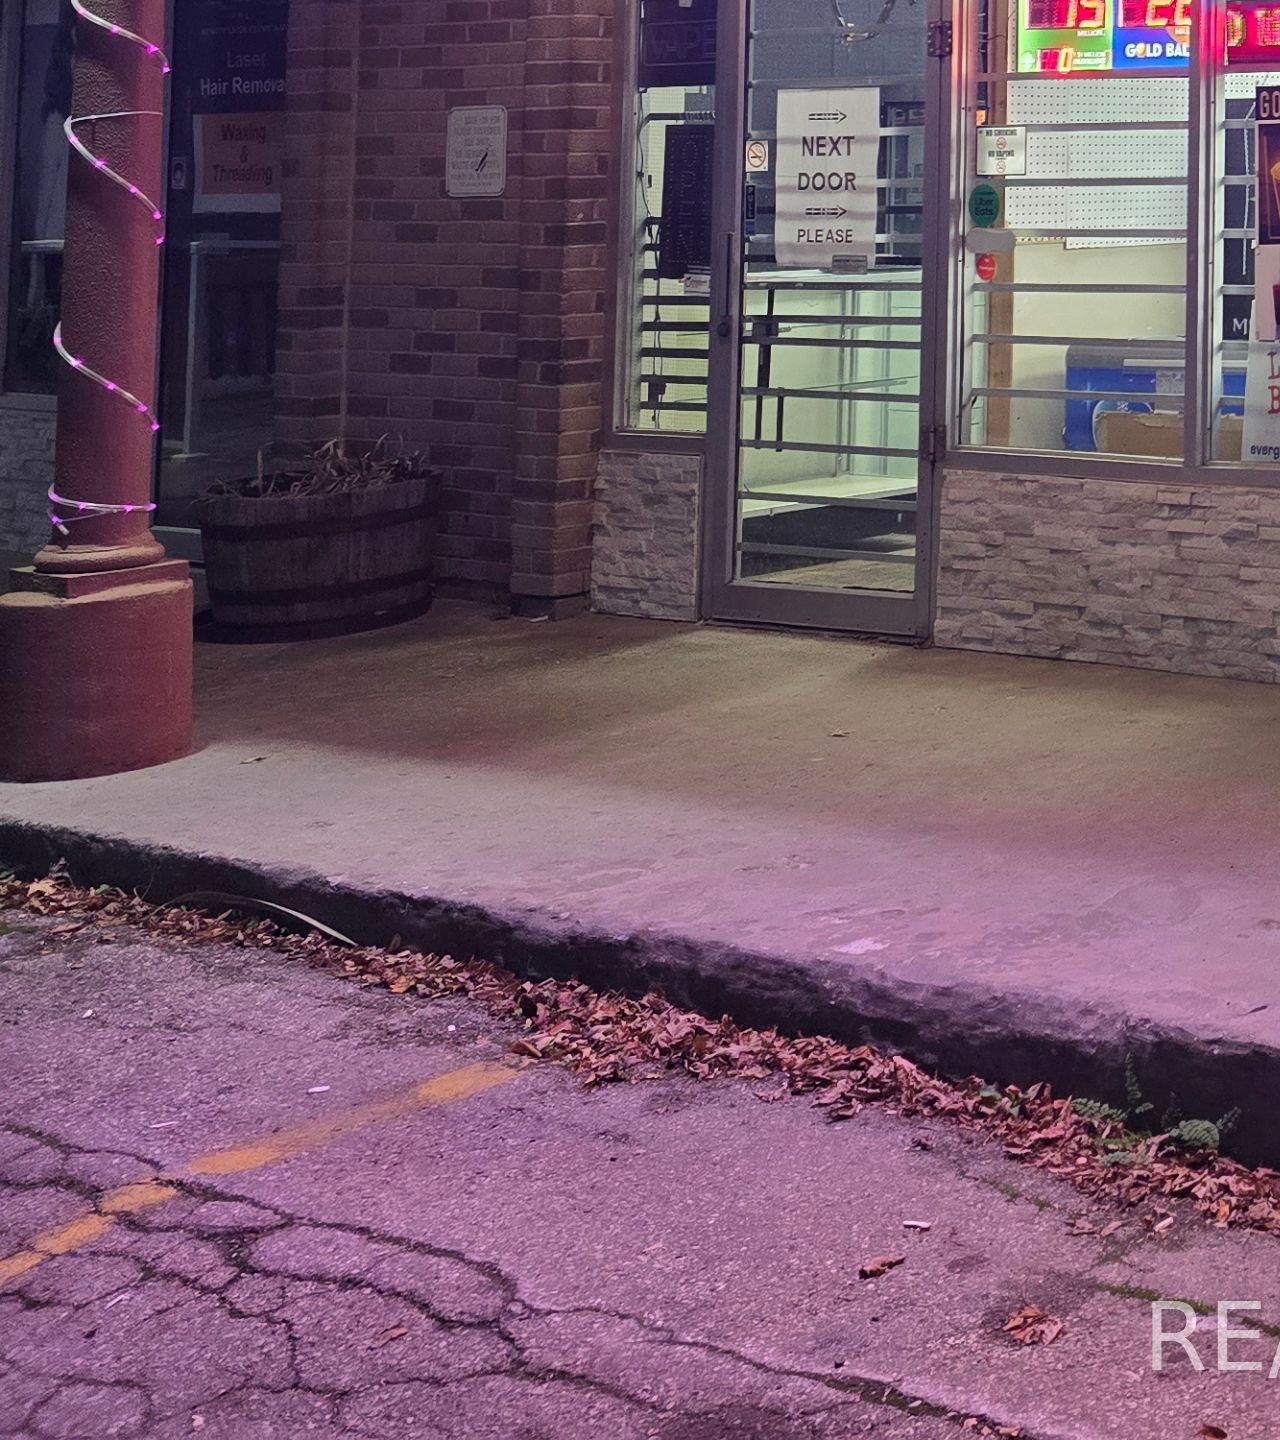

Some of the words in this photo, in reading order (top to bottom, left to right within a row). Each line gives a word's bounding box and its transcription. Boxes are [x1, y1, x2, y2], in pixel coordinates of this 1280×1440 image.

[200, 77, 229, 96] Hair
[221, 123, 267, 146] Waxing
[801, 135, 855, 158] NEXT
[211, 163, 274, 187] Threading
[797, 170, 857, 193] DOOR
[796, 227, 854, 245] PLEASE
